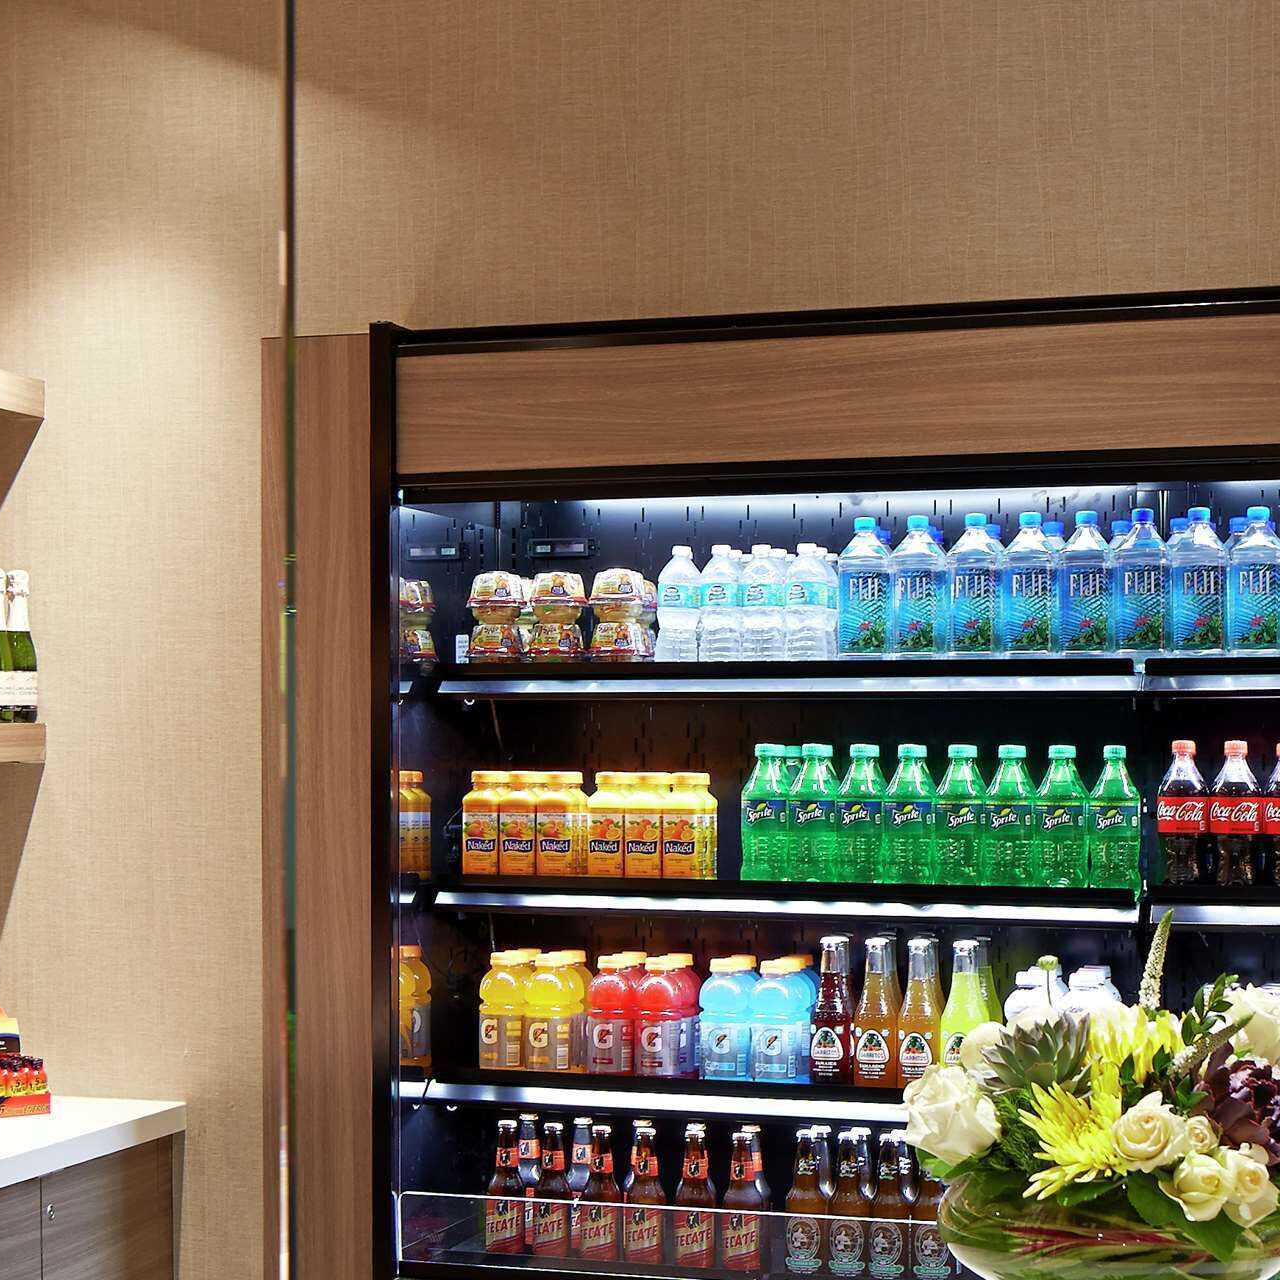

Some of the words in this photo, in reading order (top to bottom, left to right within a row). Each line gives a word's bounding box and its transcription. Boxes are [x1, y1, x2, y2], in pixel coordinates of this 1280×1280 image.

[849, 578, 879, 601] FIJI
[896, 577, 926, 600] FIJI
[955, 575, 986, 599] FIJI
[1012, 574, 1044, 597] FIJI
[1069, 573, 1101, 597] FIJI
[1124, 571, 1157, 594] FIJI
[1183, 571, 1216, 595] FIJI
[1239, 571, 1271, 594] FIJI
[747, 807, 773, 823] Sprite
[797, 807, 823, 823] Sprite
[842, 808, 869, 825] Sprite
[893, 809, 920, 825] Sprite
[948, 811, 975, 827] Sprite
[991, 812, 1018, 828] Sprite
[1043, 812, 1071, 829] Sprite
[1096, 813, 1124, 829] Sprite
[1157, 801, 1205, 822] Coca-Cola
[1210, 801, 1258, 822] Coca-Cola
[480, 1019, 499, 1045] G
[528, 1022, 549, 1048] G
[593, 1023, 614, 1049] G
[641, 1026, 663, 1052] G
[708, 1027, 732, 1054] G
[761, 1027, 784, 1054] G
[533, 1219, 563, 1236] ECATE
[724, 1231, 757, 1249] ECATE
